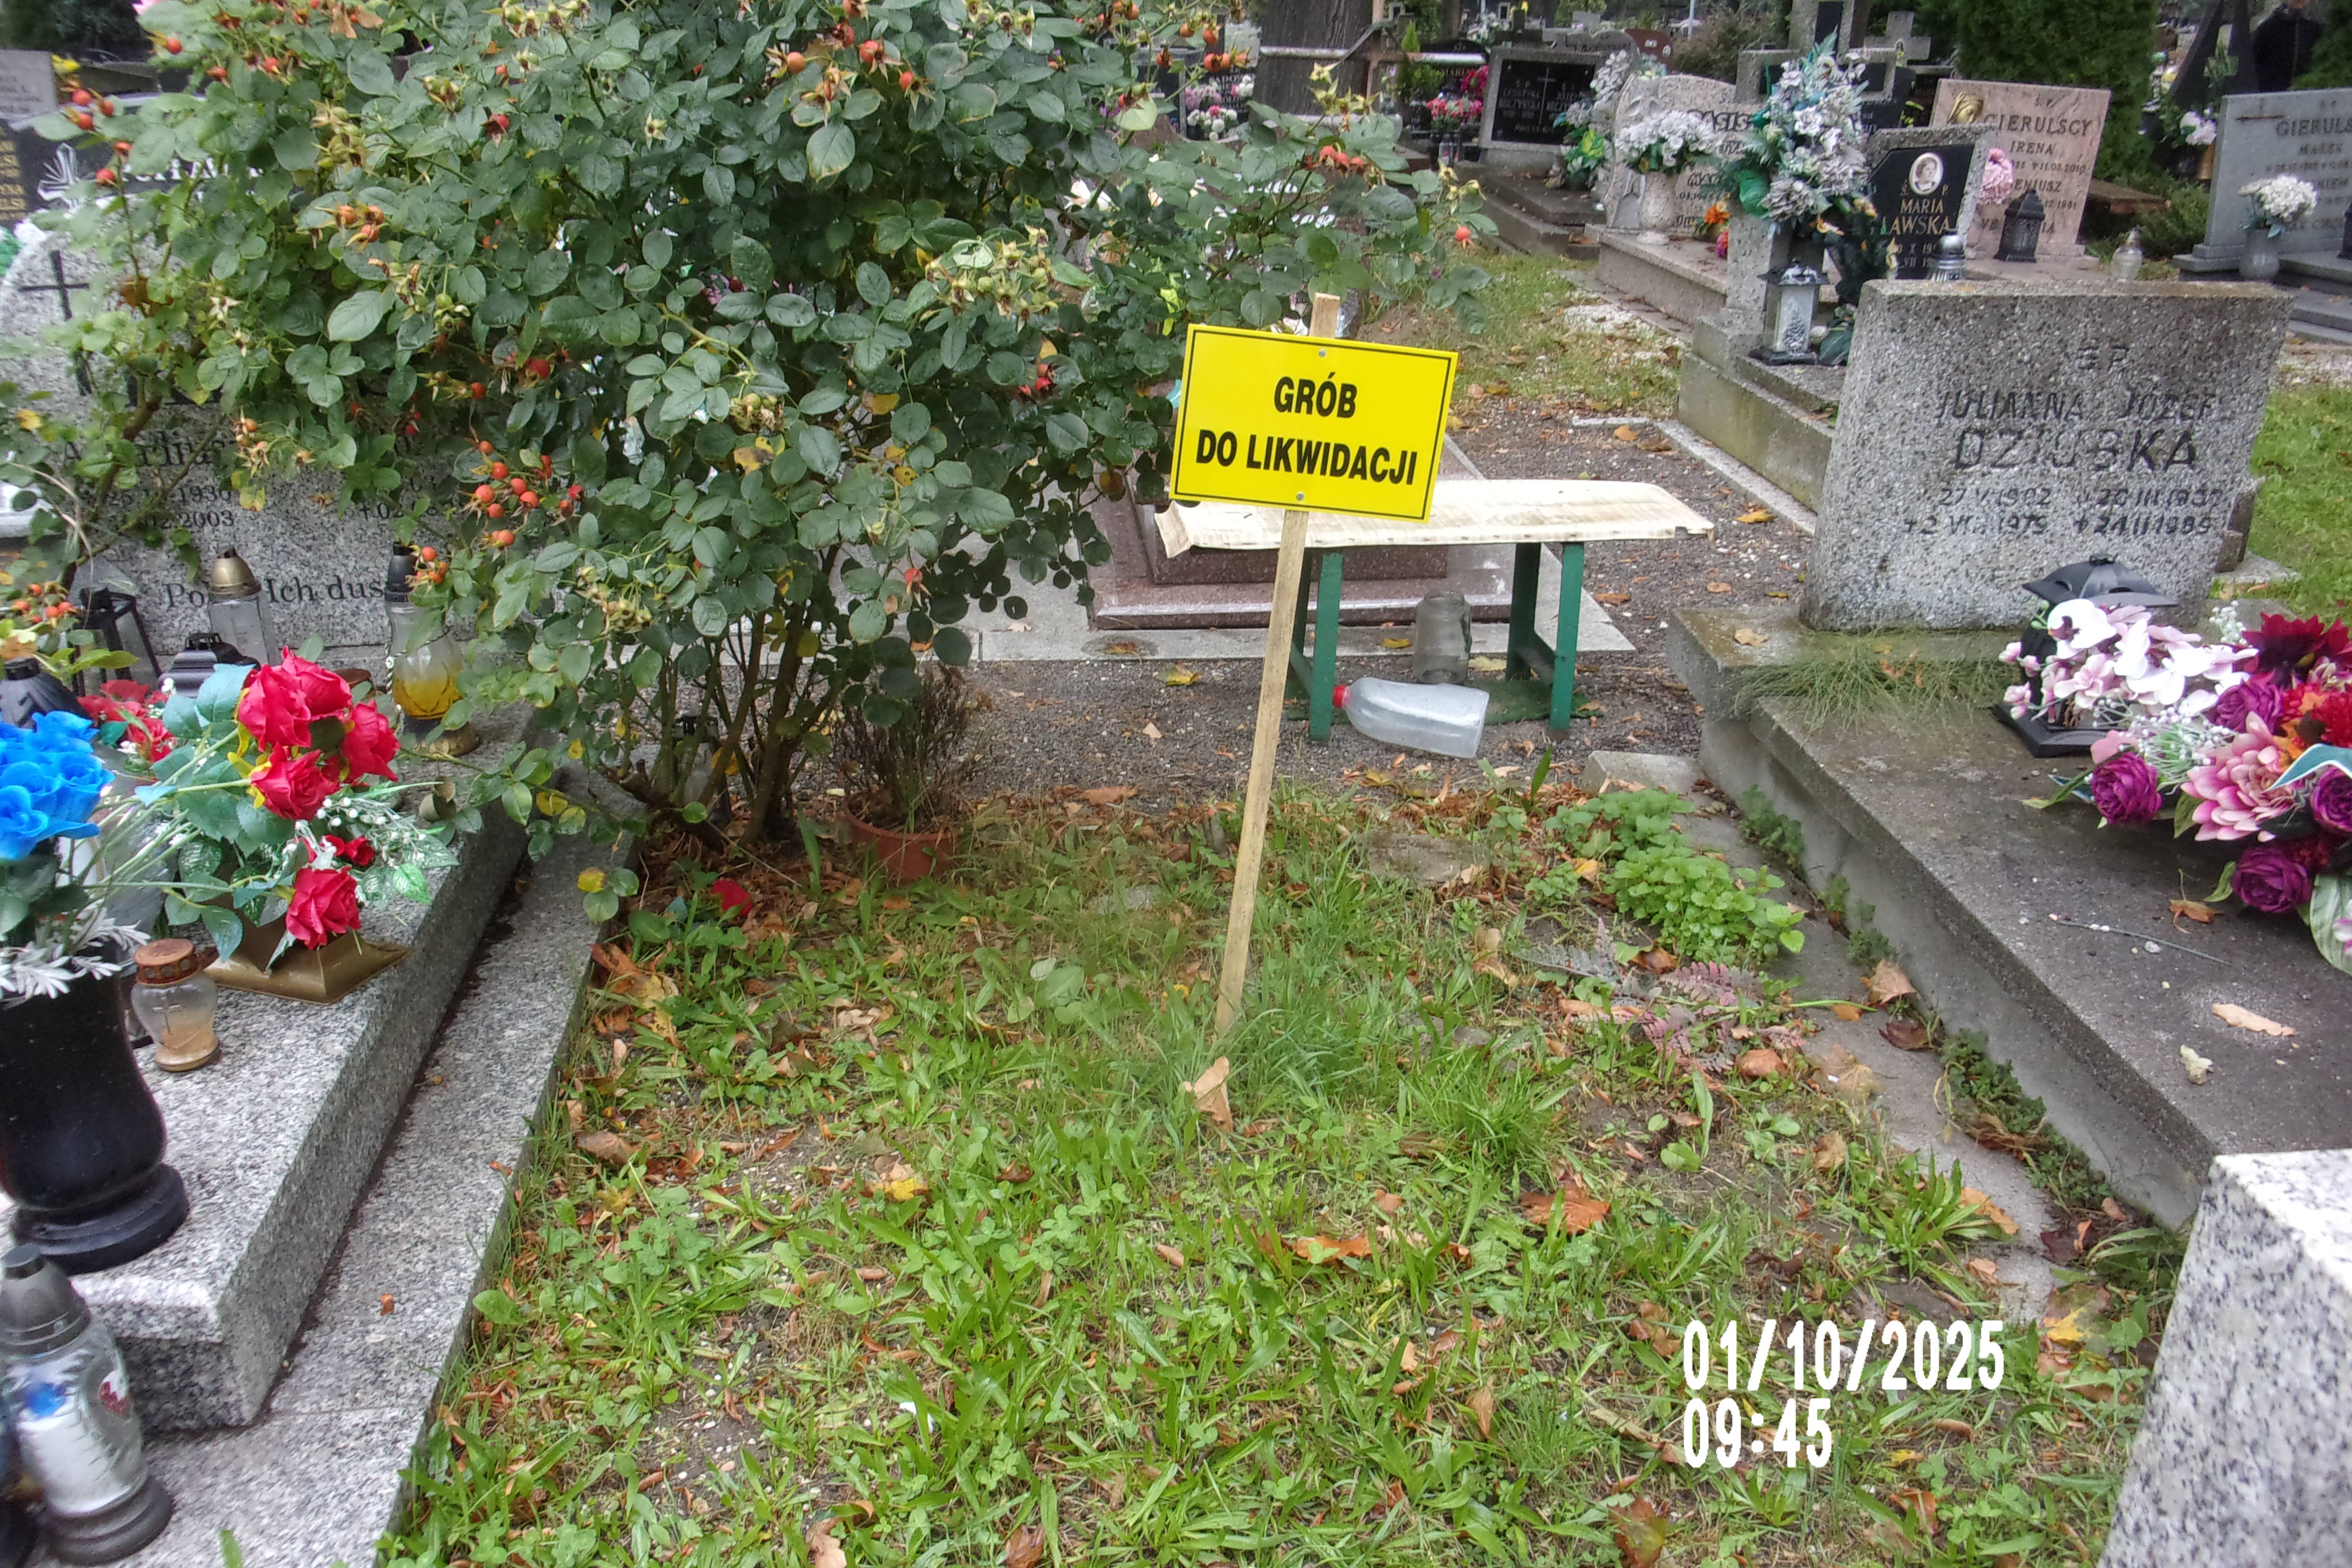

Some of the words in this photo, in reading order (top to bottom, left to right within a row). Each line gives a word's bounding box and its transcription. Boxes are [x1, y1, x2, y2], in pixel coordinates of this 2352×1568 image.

[2010, 140, 2055, 155] IRENA
[2014, 179, 2063, 192] ENIUSZ
[1900, 198, 1944, 214] MARIA
[1274, 372, 1358, 419] GRÓB
[1934, 389, 2084, 421] JULIANNA
[1195, 429, 1237, 467] DO
[1246, 434, 1418, 485] LIKWIDACJI
[264, 576, 314, 603] Ich
[328, 574, 384, 600] dus
